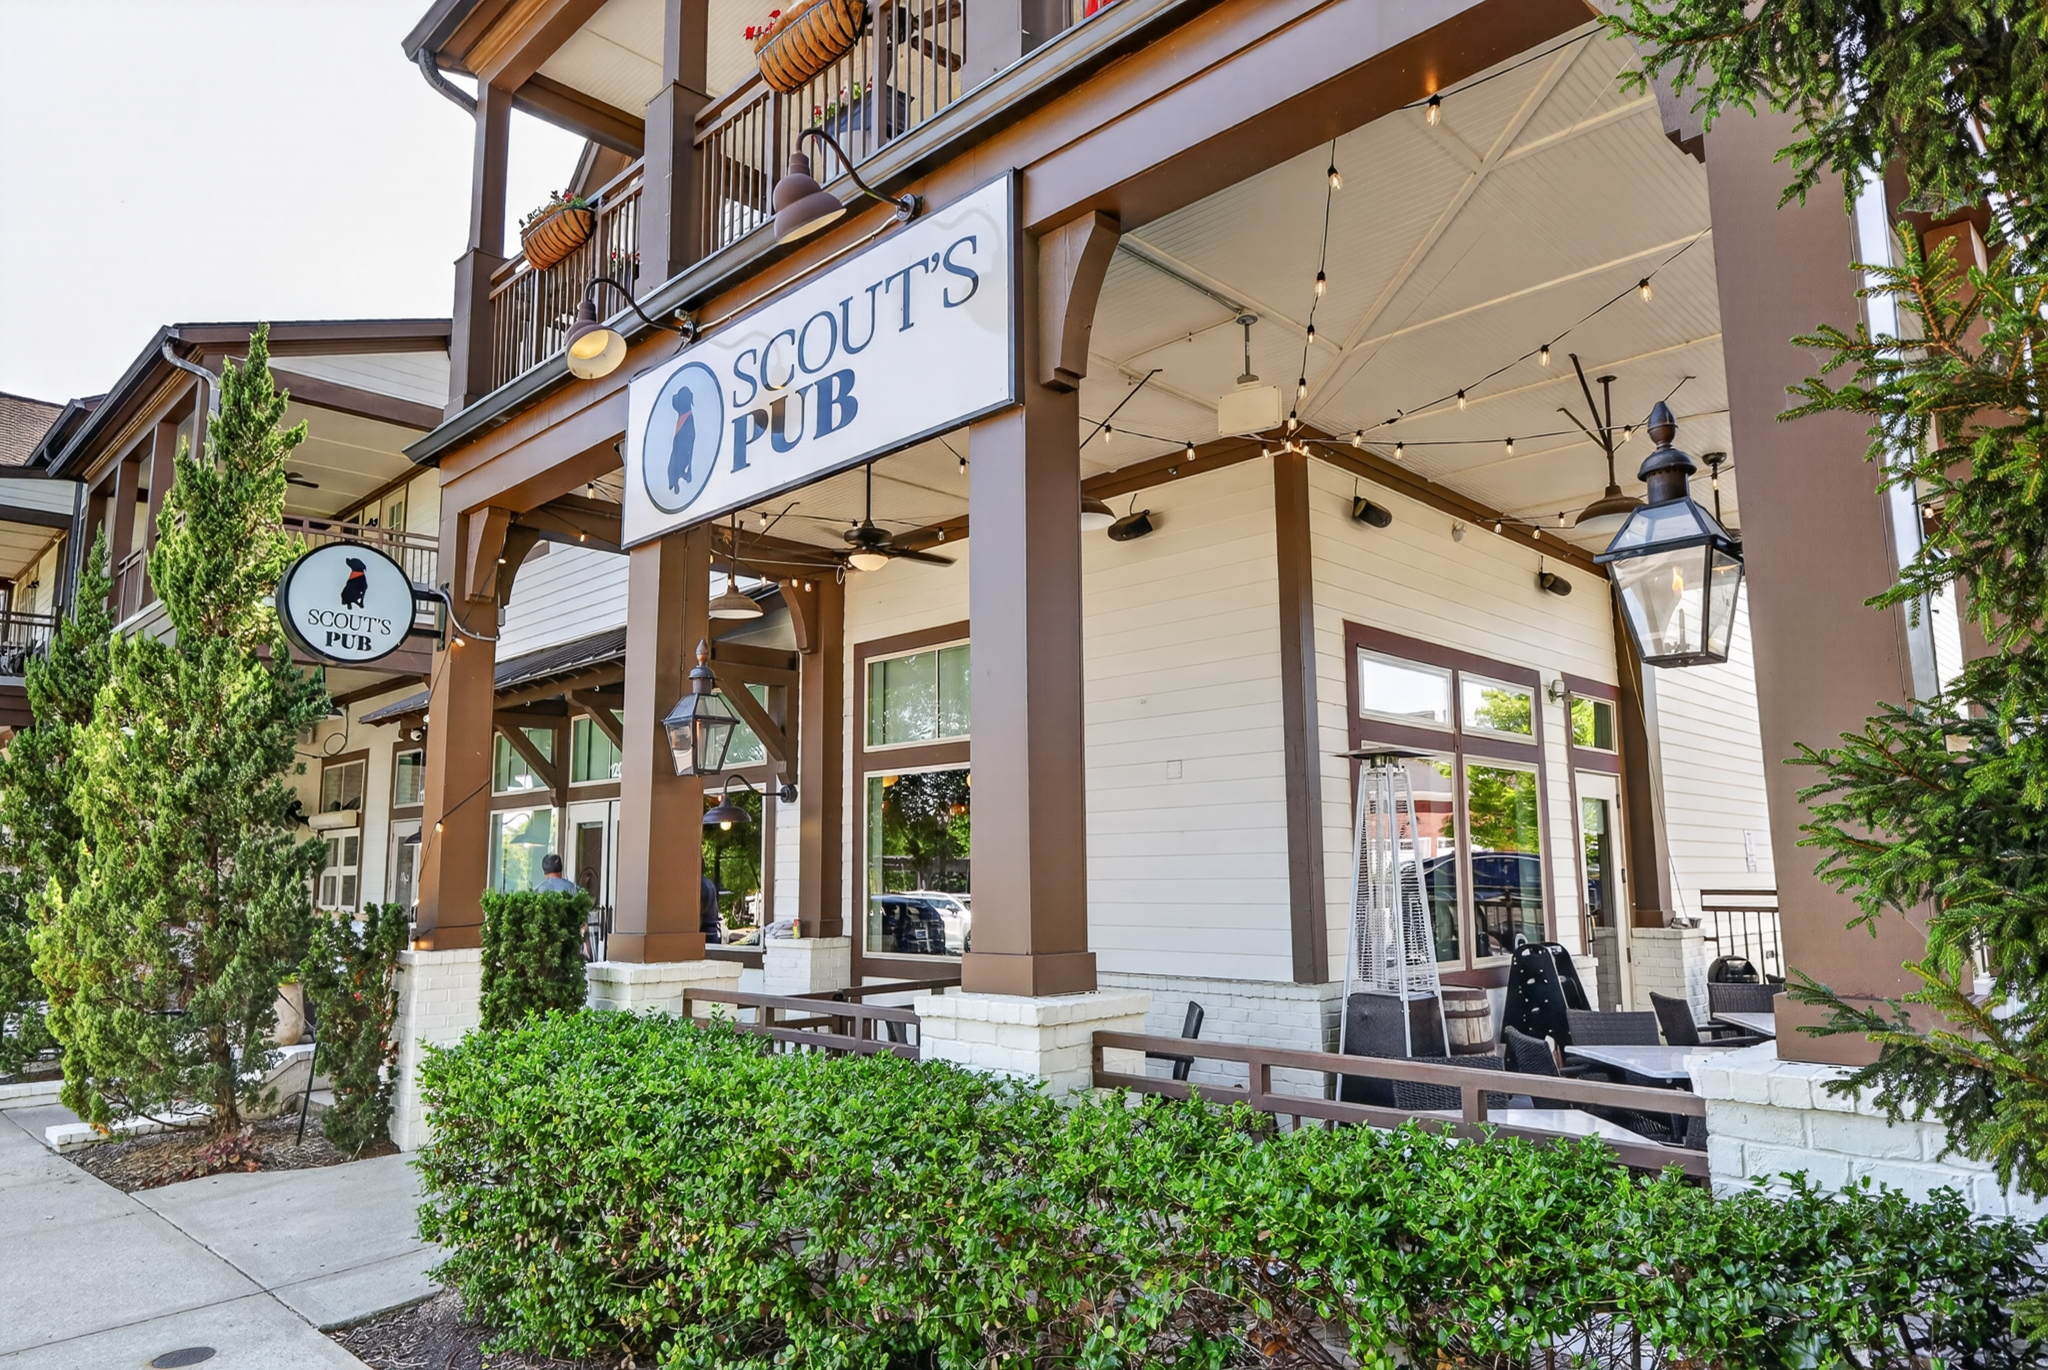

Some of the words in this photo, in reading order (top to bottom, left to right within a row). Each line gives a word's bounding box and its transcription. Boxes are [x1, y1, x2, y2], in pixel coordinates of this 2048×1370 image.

[732, 235, 979, 408] SCOUT'S
[731, 369, 858, 474] PUB
[308, 609, 391, 635] SCOUT'S
[325, 631, 372, 651] PUB
